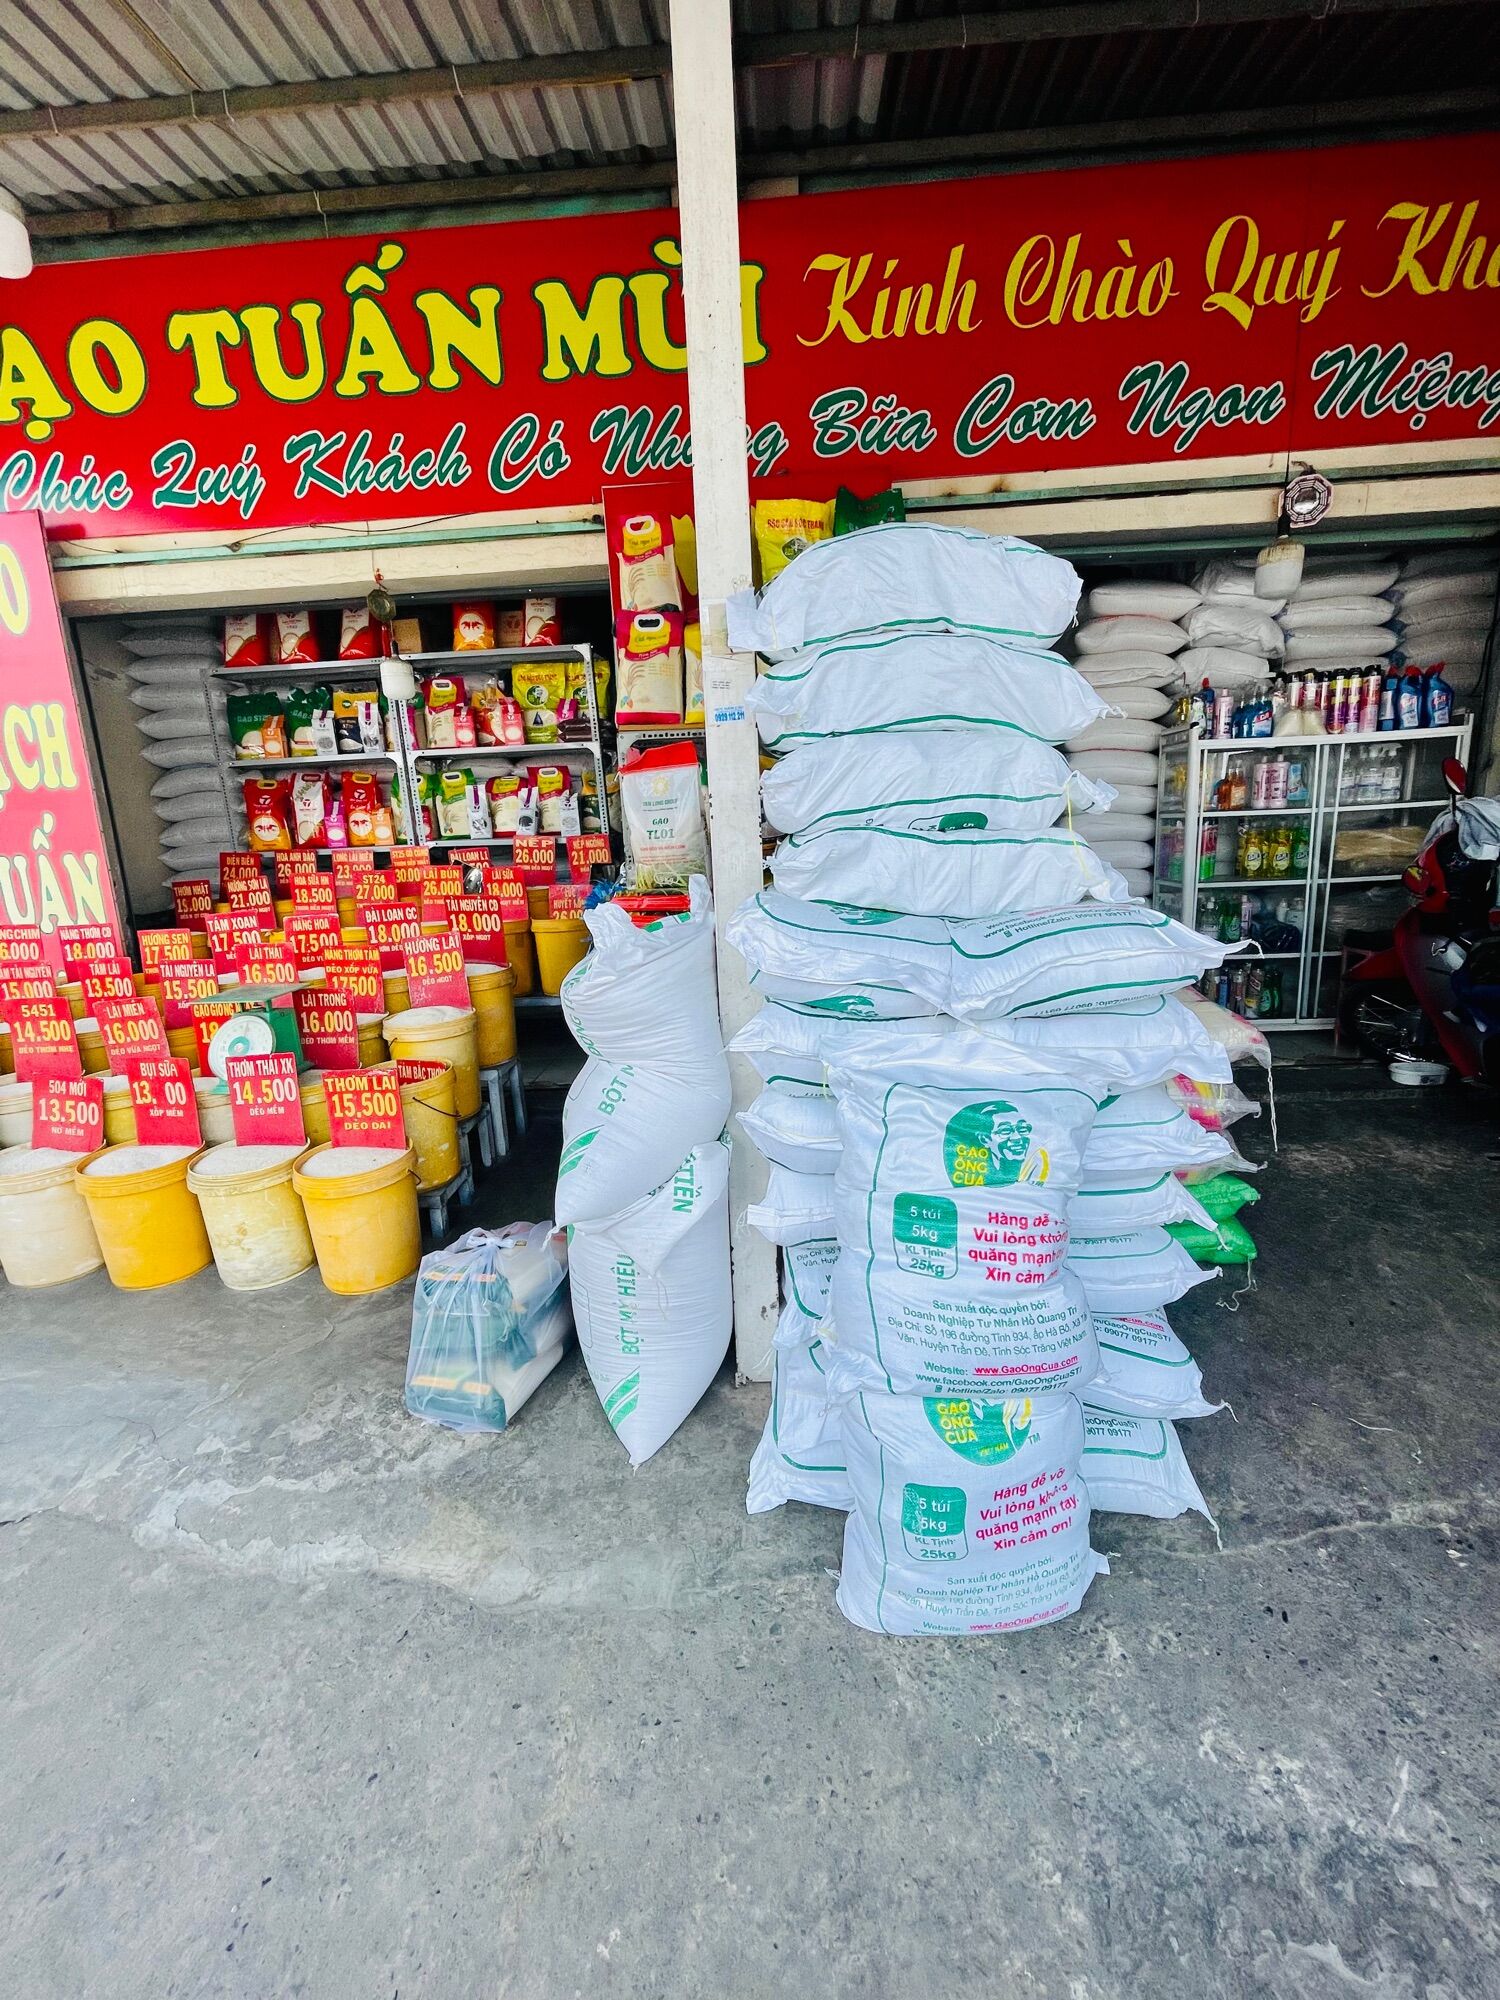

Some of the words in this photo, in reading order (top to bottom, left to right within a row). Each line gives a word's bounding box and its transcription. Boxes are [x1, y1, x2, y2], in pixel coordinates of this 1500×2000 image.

[797, 244, 981, 347] Kính
[1005, 233, 1180, 329] Chào
[1203, 215, 1344, 331] Quý
[167, 240, 502, 408] TUẤN
[0, 449, 133, 513] Chúc
[152, 440, 265, 519] Quý
[284, 422, 472, 498] Khách
[487, 412, 571, 493] Có
[810, 387, 936, 458] Bữa
[953, 374, 1096, 457] Cơm
[1119, 361, 1285, 452] Ngon
[646, 828, 676, 841] TL01
[516, 849, 554, 864] 26.000
[571, 848, 609, 866] 21.000
[362, 874, 386, 884] ST24
[295, 888, 332, 903] 18.500
[355, 884, 395, 900] 27.000
[423, 881, 461, 896] 26.000
[486, 882, 523, 898] 18.000
[177, 896, 212, 912] 15.000
[230, 891, 271, 909] 21.000
[231, 915, 258, 930] XOAN
[365, 907, 380, 922] ĐÀI
[382, 909, 404, 921] LOAN
[405, 906, 418, 919] GC
[449, 912, 501, 933] 18.000
[313, 917, 330, 930] HOA
[141, 933, 170, 946] HƯƠNG
[171, 933, 189, 944] SEN
[368, 922, 421, 944] 18.000
[64, 941, 116, 962] 18.000
[404, 937, 440, 956] HƯƠNG
[441, 931, 460, 951] LÀI
[408, 950, 464, 978] 16.500
[242, 962, 296, 985] 16.500
[1, 980, 54, 1000] 15.000
[85, 977, 133, 998] 13.500
[163, 978, 217, 1000] 15.500
[301, 990, 316, 1007] LÀI
[317, 993, 348, 1007] TRONG
[21, 1003, 56, 1018] 5451
[300, 1010, 354, 1033] 16.000
[13, 1020, 71, 1043] 14.500
[103, 1018, 160, 1046] 16.000
[140, 1061, 158, 1078] BỤI
[228, 1059, 255, 1078] THƠM
[255, 1053, 279, 1075] THÁI
[280, 1057, 294, 1075] XK
[48, 1080, 68, 1096] 504
[69, 1077, 87, 1096] MỚI
[231, 1077, 298, 1106] 14.500
[324, 1073, 369, 1093] THƠM
[38, 1097, 100, 1126] 13.500
[331, 1092, 398, 1119] 15.500
[343, 1118, 369, 1131] DẺO
[371, 1120, 392, 1131] DAI
[910, 1206, 918, 1218] 5
[921, 1206, 941, 1220] túi
[988, 1212, 1029, 1230] Hàng
[911, 1225, 939, 1242] 5kg
[974, 1228, 999, 1243] Vui
[1003, 1229, 1037, 1247] lòng
[905, 1245, 921, 1256] KL
[968, 1249, 1017, 1266] quăng
[910, 1258, 945, 1277] 25kg
[986, 1267, 1012, 1283] Xin
[1015, 1267, 1045, 1284] cảm
[903, 1306, 937, 1323] Doanh
[938, 1314, 975, 1329] Nghiệp
[977, 1317, 990, 1328] Tư
[993, 1317, 1019, 1328] Nhân
[1021, 1314, 1035, 1326] Hồ
[1036, 1311, 1067, 1325] Quang
[993, 1482, 1028, 1503] Hàng
[1030, 1471, 1047, 1490] dễ
[931, 1498, 951, 1513] túi
[980, 1504, 1002, 1521] Vui
[1005, 1496, 1036, 1514] lòng
[920, 1516, 948, 1533] 5kg
[975, 1517, 1019, 1541] quăng
[1021, 1507, 1058, 1525] mạnh
[993, 1537, 1016, 1552] Xin
[1020, 1528, 1048, 1546] cảm
[1050, 1516, 1073, 1534] ơn!
[920, 1549, 957, 1560] 25kg
[1041, 1562, 1068, 1579] Quang
